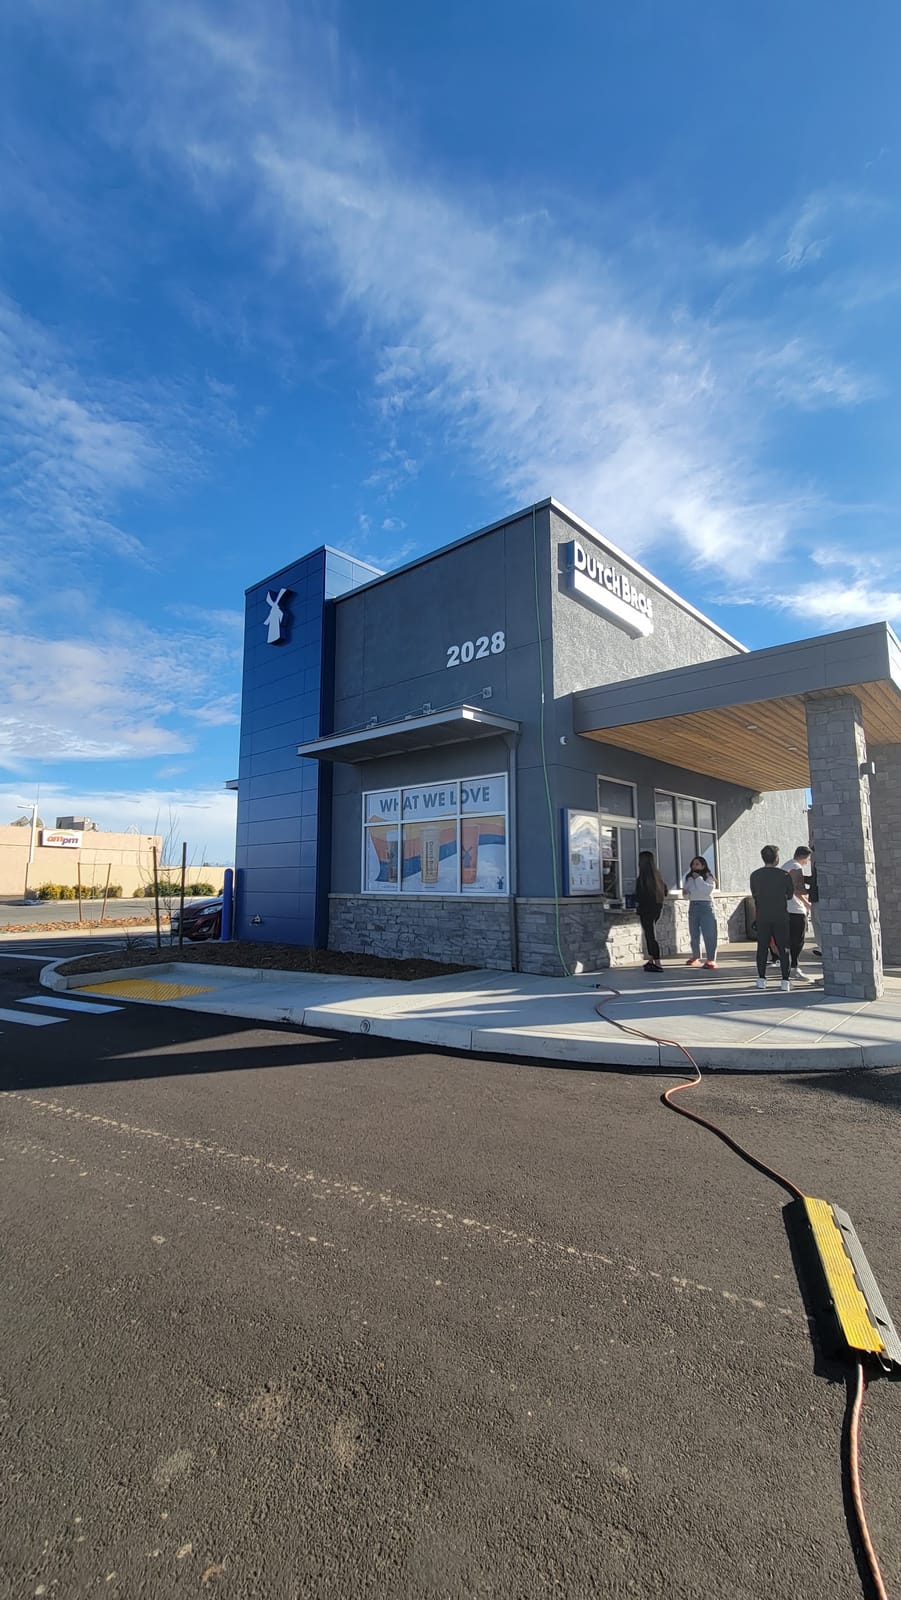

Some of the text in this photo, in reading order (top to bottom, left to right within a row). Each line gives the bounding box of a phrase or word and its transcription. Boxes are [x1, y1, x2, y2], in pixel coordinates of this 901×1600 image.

[574, 540, 653, 618] DUTCH BROS
[446, 631, 506, 668] 2028
[379, 786, 490, 813] WHAT WE LOVE
[47, 835, 78, 845] ampm
